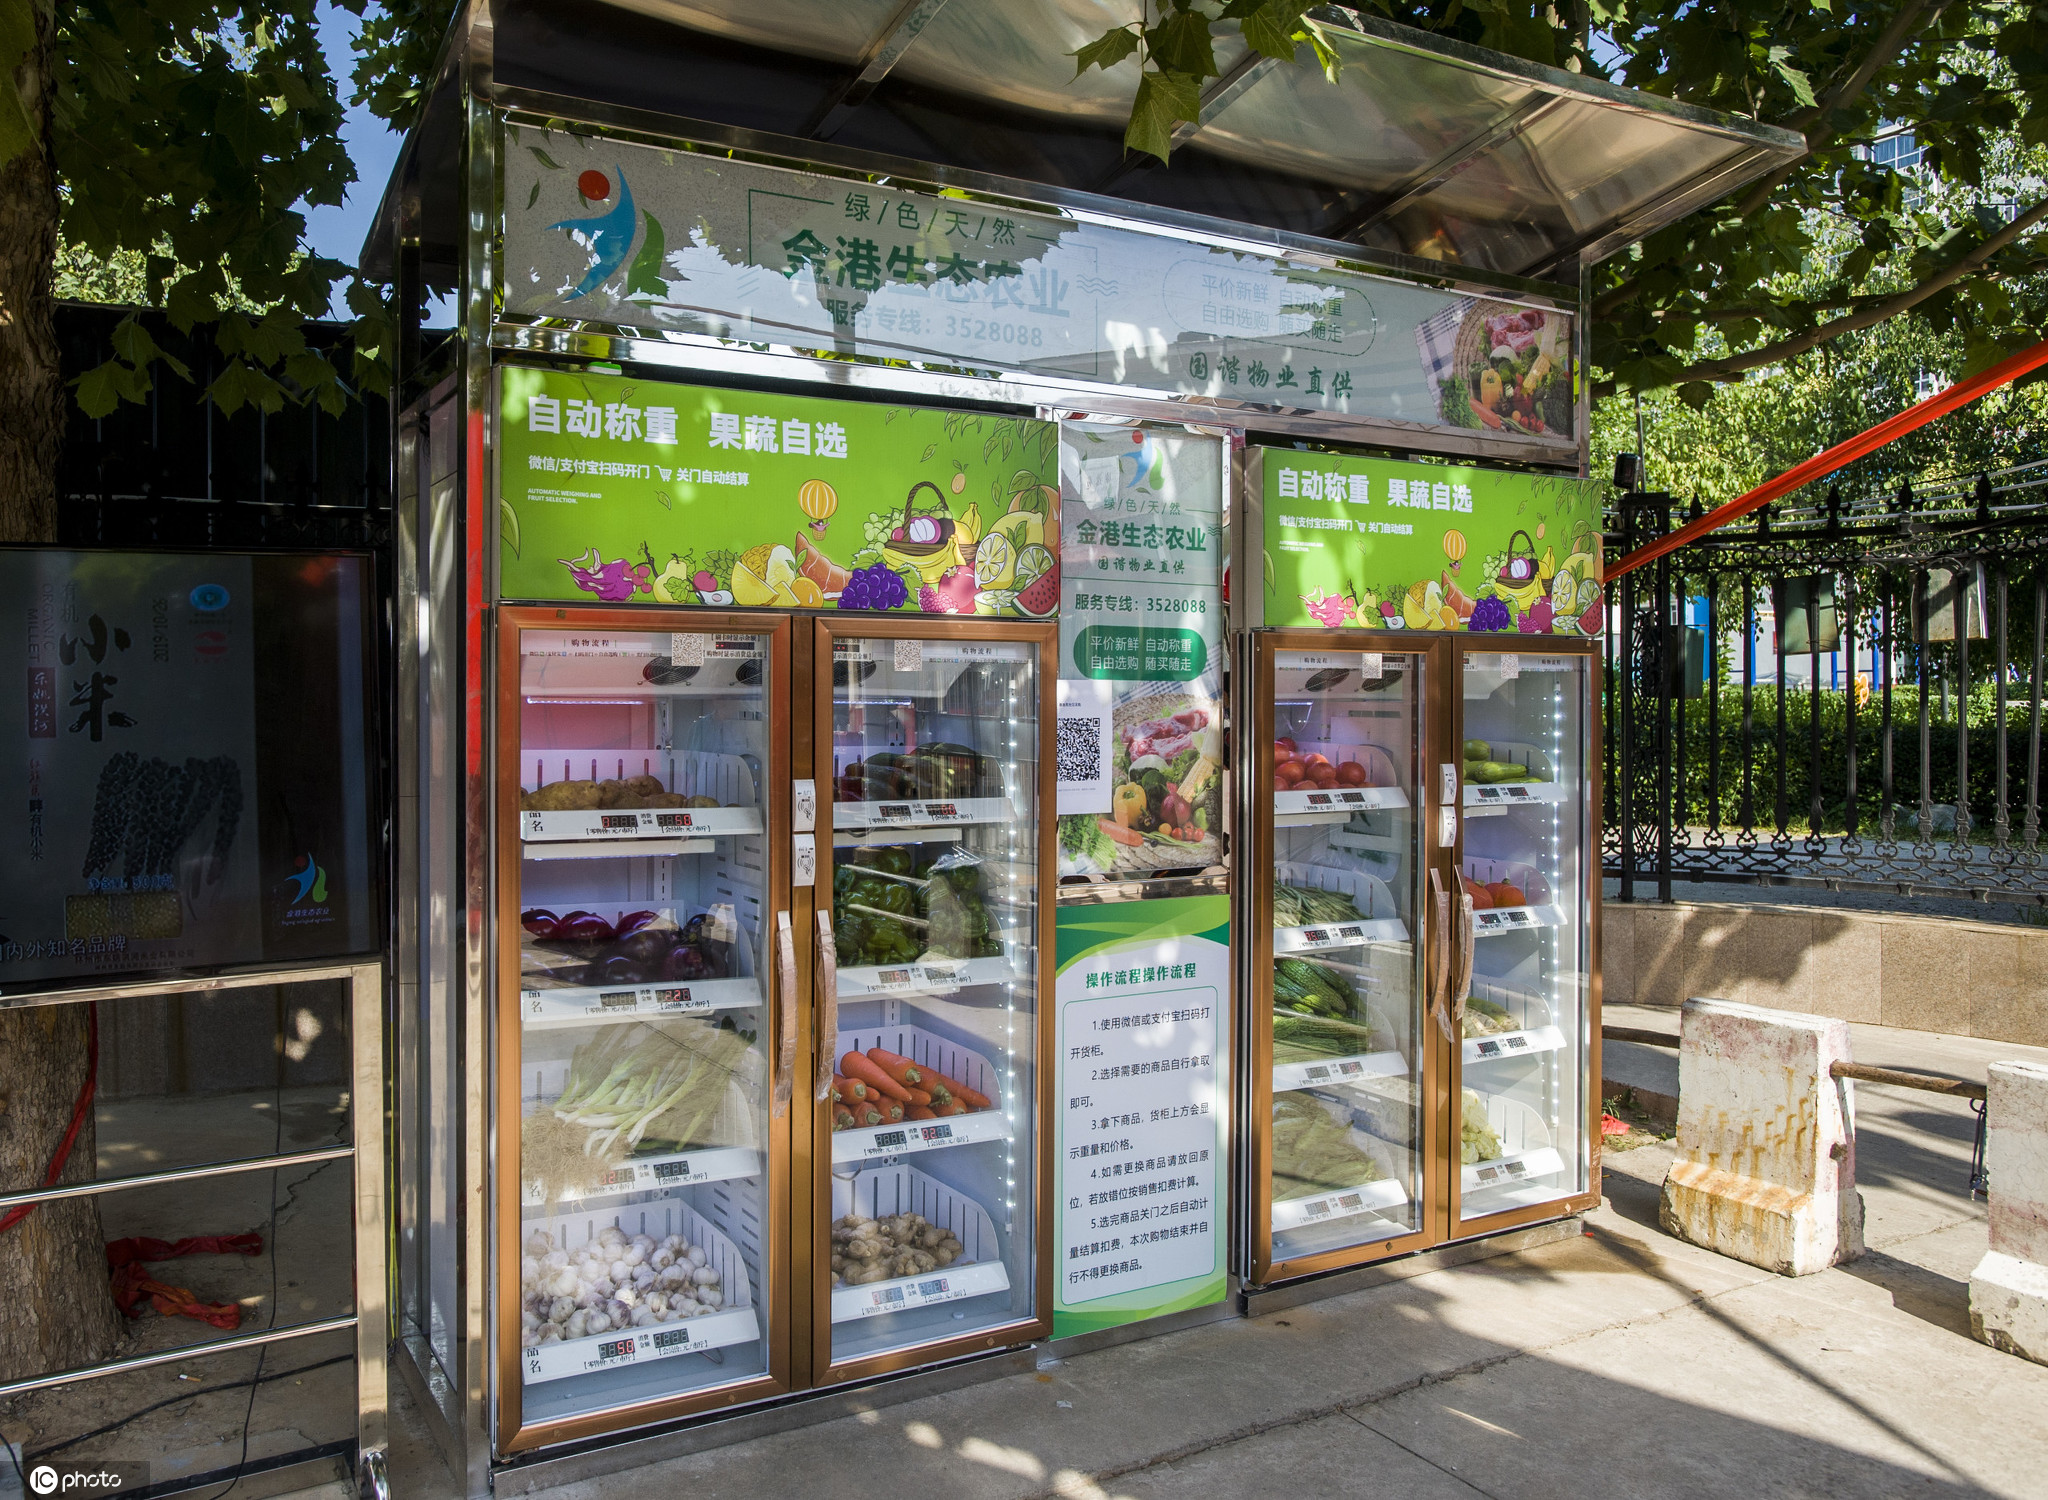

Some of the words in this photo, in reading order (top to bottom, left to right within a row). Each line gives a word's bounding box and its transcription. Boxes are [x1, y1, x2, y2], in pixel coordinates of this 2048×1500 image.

[844, 191, 1016, 246] 绿/色/天/然
[781, 227, 1071, 319] 金港生态农业
[1201, 273, 1269, 304] 平价新鲜
[1279, 286, 1343, 317] 自动称重
[1202, 301, 1269, 334] 自由选购
[1278, 313, 1343, 345] 随买随走
[528, 394, 678, 444] 自动称重
[708, 412, 848, 459] 果蔬自选
[528, 455, 650, 478] 微信/支付宝扫码开门
[676, 467, 749, 486] 关门自动结算
[528, 488, 560, 496] AUTOMATIC
[528, 494, 544, 502] FRUIT
[1278, 467, 1370, 504] 自动称重
[1387, 478, 1472, 513] 果蔬自选
[1103, 497, 1181, 516] 绿/色/天/然
[1076, 518, 1207, 552] 金港生态农业
[1279, 515, 1352, 532] 微信/支付宝扫码开门
[1368, 521, 1413, 536] 关门自动结算
[42, 583, 56, 652] ORGANIC
[27, 608, 41, 663] MILLET
[571, 638, 610, 648] 购物流程
[1090, 635, 1139, 652] 平价新鲜
[1146, 638, 1192, 653] 自动称重
[1090, 655, 1139, 670] 自由选购
[1145, 656, 1192, 672] 随买随走
[59, 613, 138, 742] 小米
[1086, 962, 1197, 989] 操作流程操作流程
[1092, 1007, 1210, 1031] 1.使用微信或支付宝扫码打
[1070, 1044, 1104, 1060] 开货柜。
[1091, 1055, 1210, 1081] 2.选择需要的商品自行拿取
[1070, 1096, 1094, 1109] 即可。
[1069, 1138, 1134, 1160] 示重量和价格。
[1090, 1149, 1209, 1179] 4.如需更换商品请放回原
[1090, 1198, 1209, 1229] 5.选完商品关门之后自动计
[1069, 1258, 1143, 1285] 行不得更换商品。
